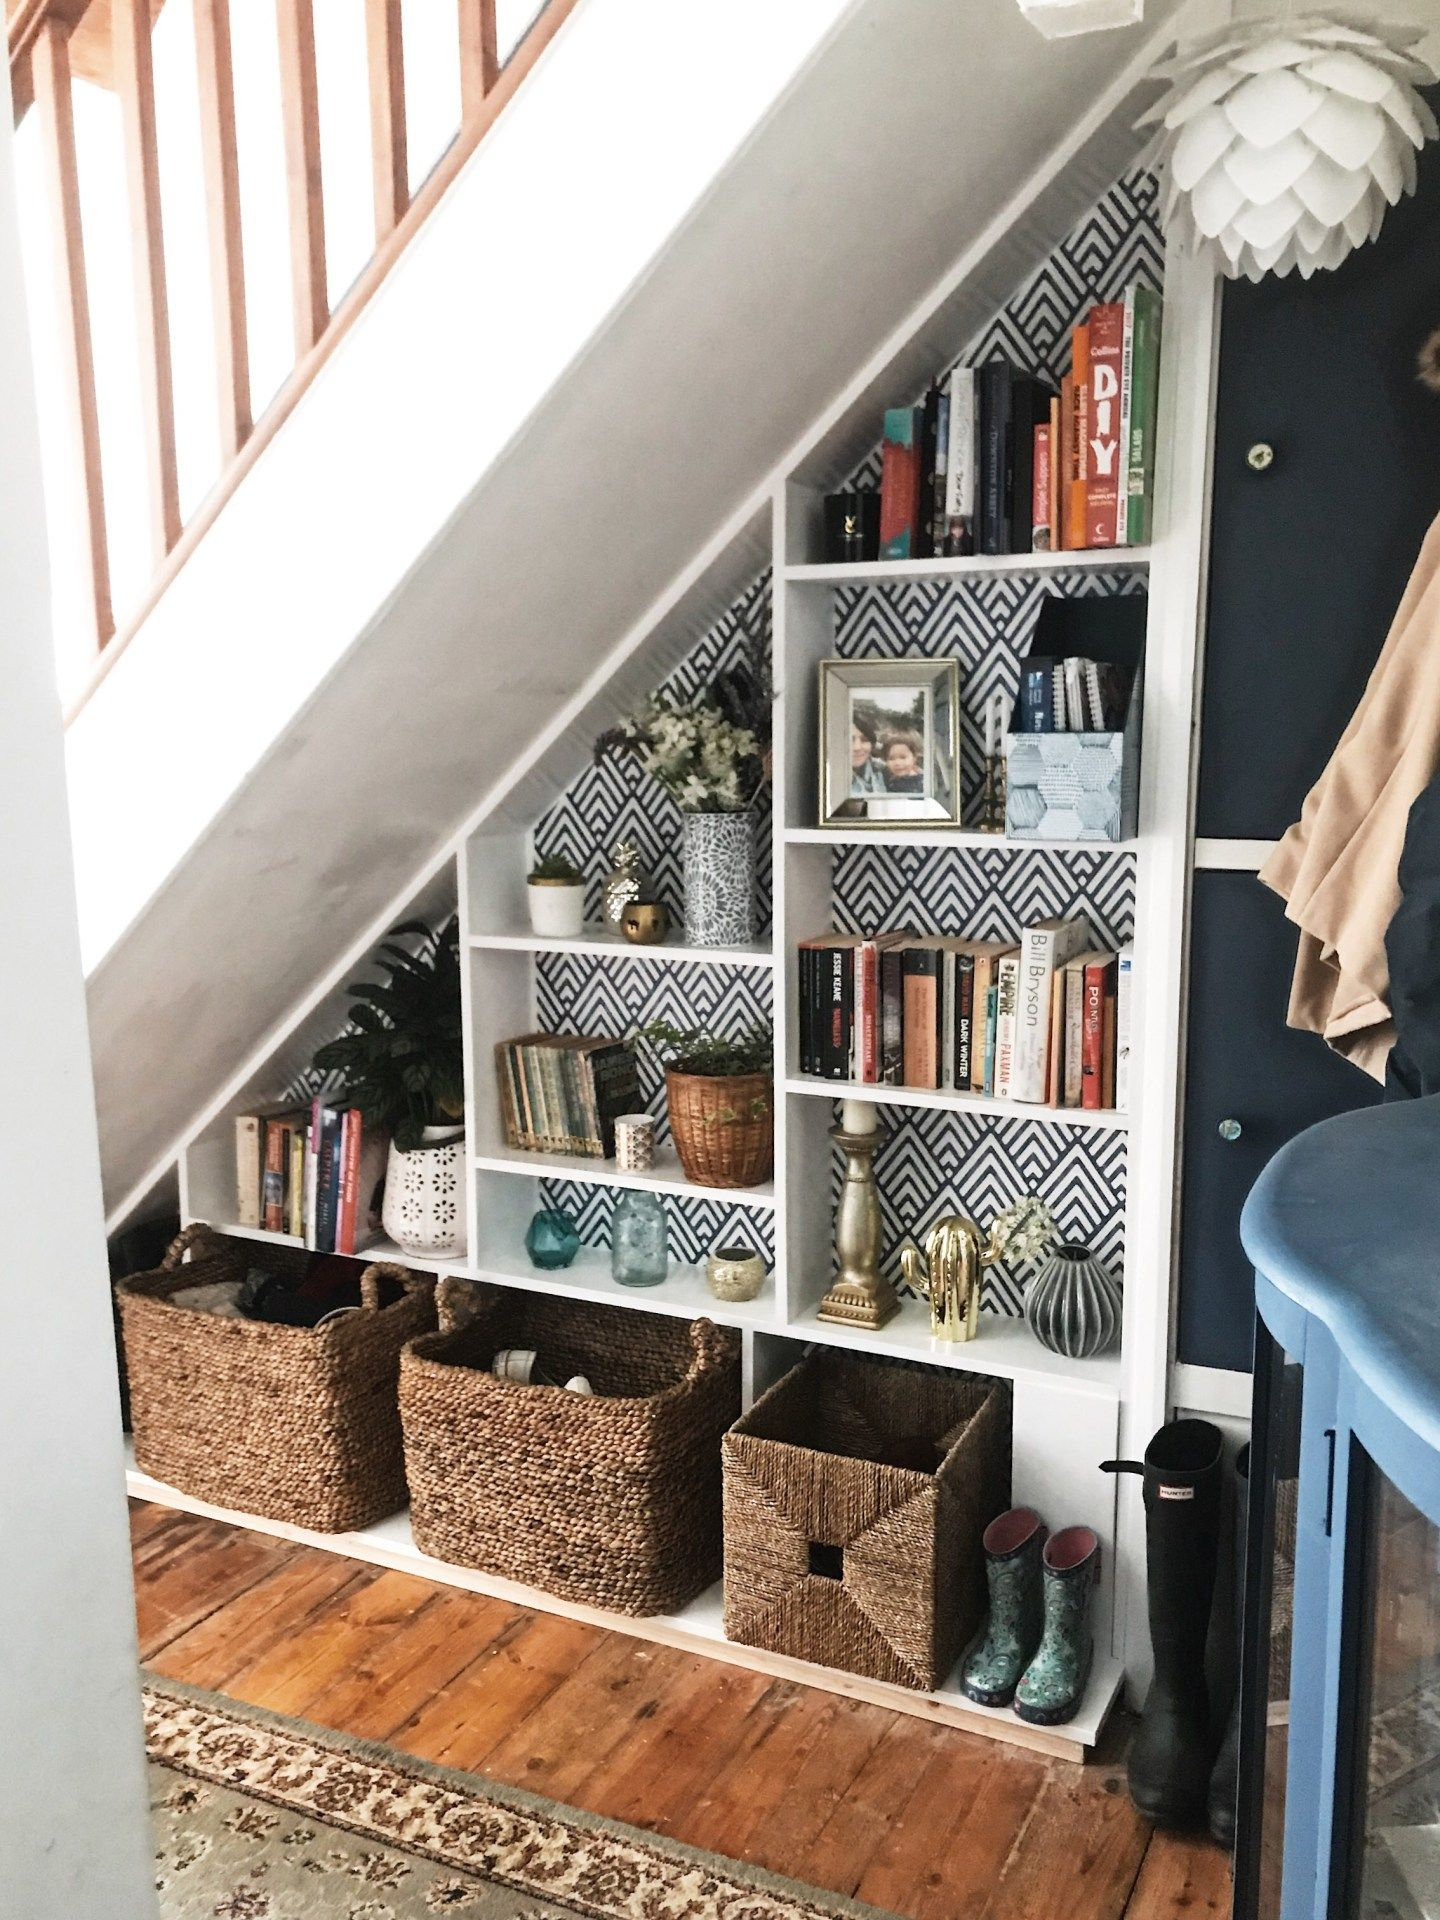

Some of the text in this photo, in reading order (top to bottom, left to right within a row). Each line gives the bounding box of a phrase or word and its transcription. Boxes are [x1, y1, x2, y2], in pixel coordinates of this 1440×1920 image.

[1092, 364, 1119, 475] DIY
[1132, 428, 1143, 463] SALADS
[1036, 451, 1048, 523] Simple Suppers
[832, 952, 842, 976] JESSIE
[1031, 934, 1048, 961] Bill
[833, 977, 842, 1001] KEANE
[999, 972, 1016, 1017] EMPIRE
[1026, 965, 1046, 1027] Bryson
[960, 1018, 970, 1042] DARK
[959, 1044, 968, 1077] WINTER
[999, 1043, 1012, 1084] PAXMAN
[1161, 1489, 1192, 1497] HUNTER
